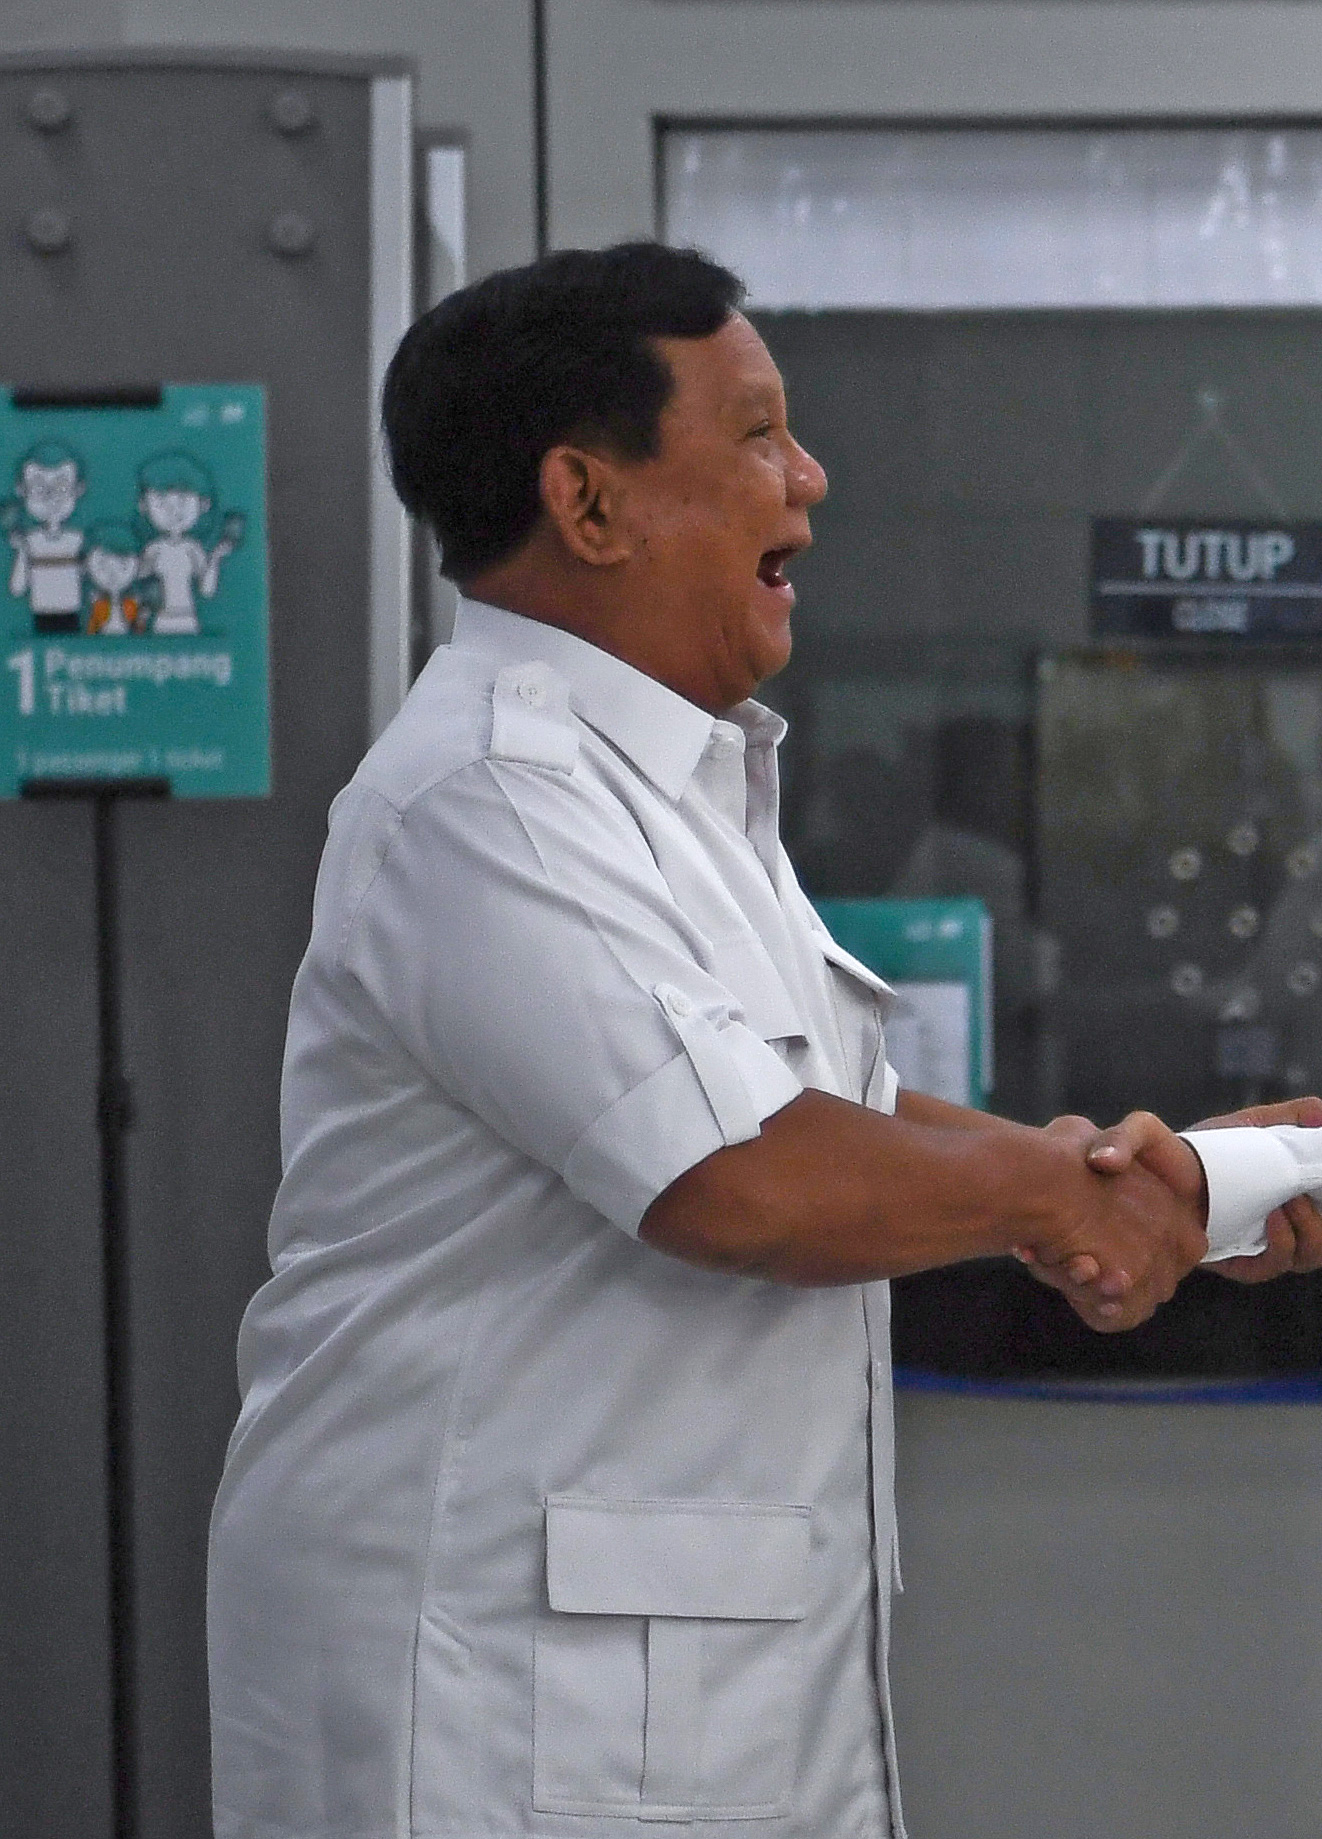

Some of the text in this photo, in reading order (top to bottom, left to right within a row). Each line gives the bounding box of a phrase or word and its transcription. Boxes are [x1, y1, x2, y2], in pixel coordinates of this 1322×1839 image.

[1136, 528, 1295, 580] TUTUP
[7, 648, 232, 716] 1 Penumpang
[47, 683, 127, 715] Tiket
